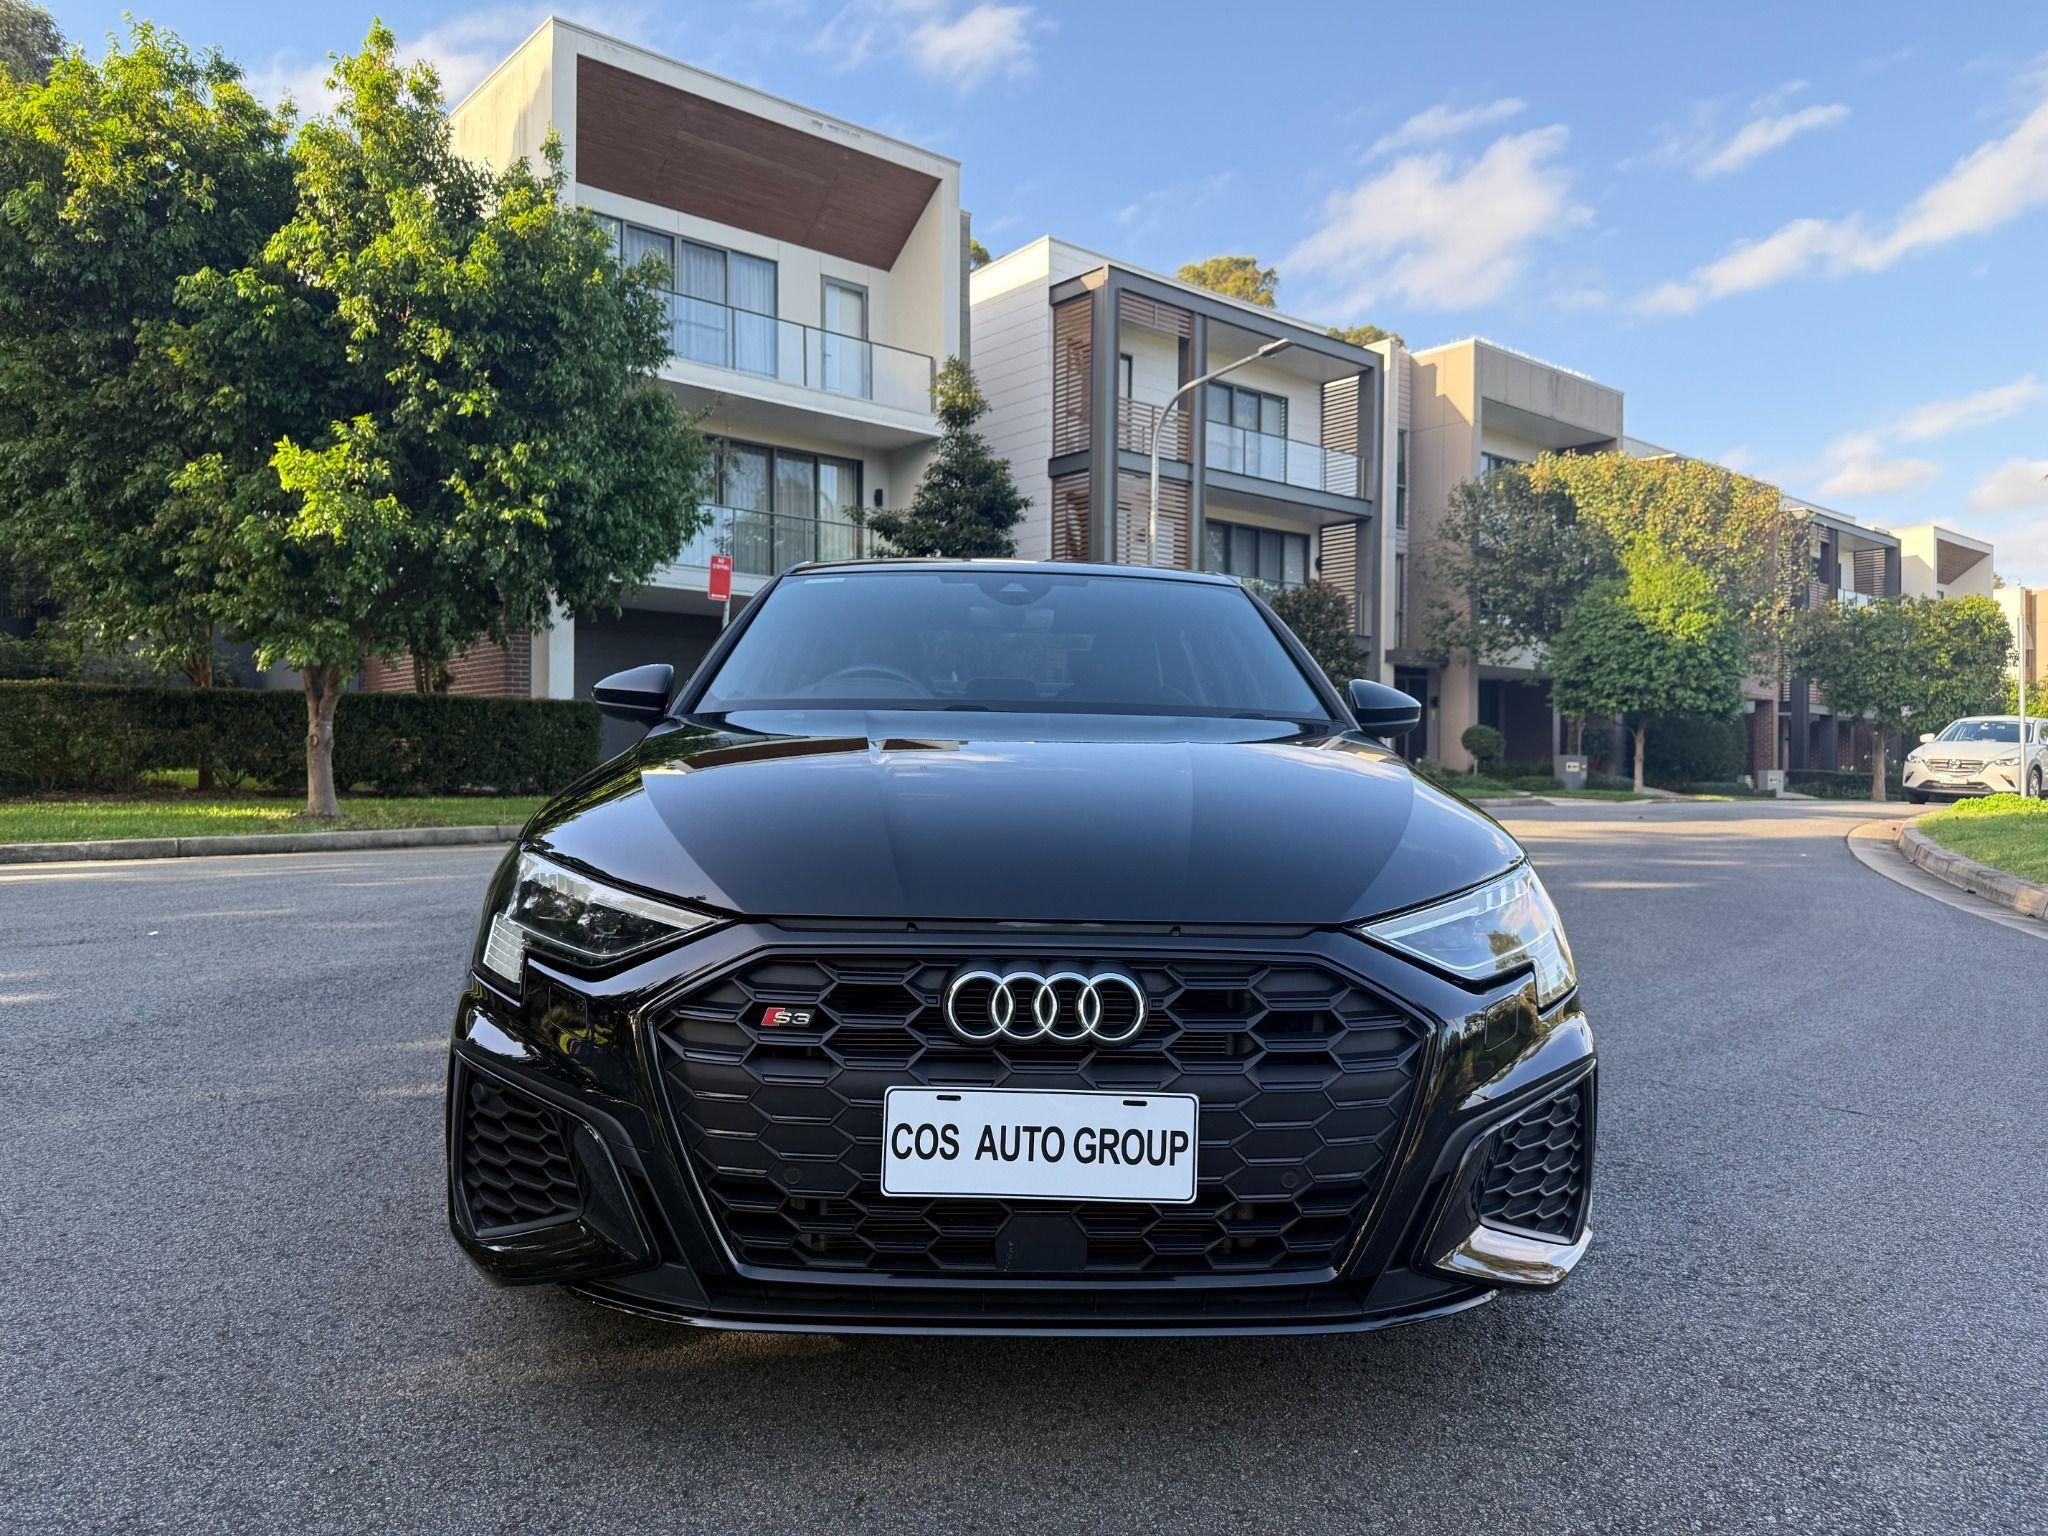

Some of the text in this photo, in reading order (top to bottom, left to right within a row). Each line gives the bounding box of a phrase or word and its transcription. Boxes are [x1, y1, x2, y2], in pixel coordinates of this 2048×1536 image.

[773, 1011, 811, 1025] S3
[891, 1122, 1189, 1167] COS AUTO GROUP
